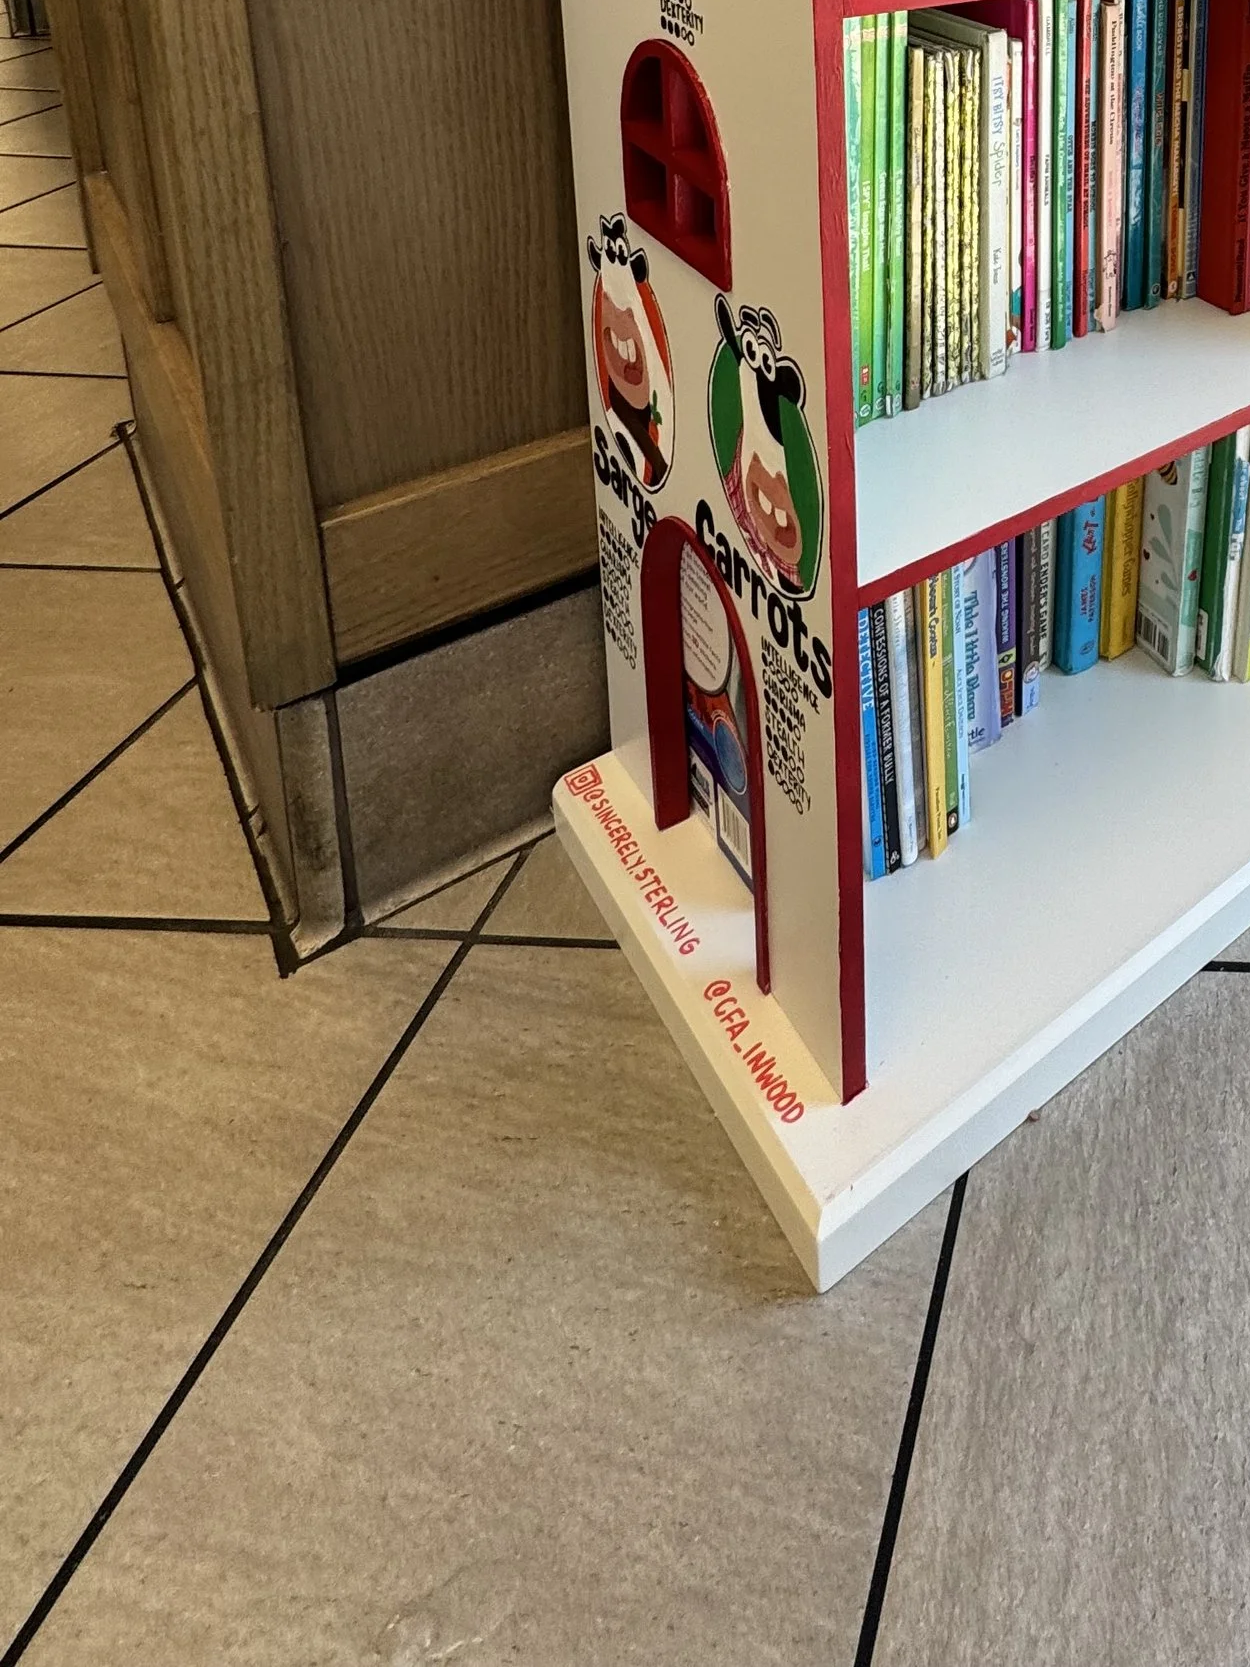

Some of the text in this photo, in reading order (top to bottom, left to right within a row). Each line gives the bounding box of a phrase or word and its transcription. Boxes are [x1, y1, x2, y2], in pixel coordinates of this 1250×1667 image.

[988, 76, 1005, 186] ITSY BITSY Spider
[1240, 114, 1250, 148] Moose
[1238, 164, 1248, 186] Give
[1238, 191, 1247, 210] You
[861, 210, 869, 245] Imagine
[594, 425, 657, 549] Sarge
[599, 508, 639, 569] INTELLIGENCE
[695, 499, 832, 698] Carrots
[1000, 541, 1008, 643] WAKING THE MONSTERS
[1039, 532, 1050, 638] CARD ENDER'S GAME
[761, 635, 820, 715] INTELLIGENCE
[762, 669, 806, 732] CHARISMA
[857, 617, 874, 710] DETECTIVE
[873, 608, 894, 785] CONFESSIONS OF A FORMER BULLY
[764, 705, 805, 769] STEALTH
[766, 741, 811, 812] DEXTERITY
[703, 979, 804, 1124] @CFA_INWOOD
